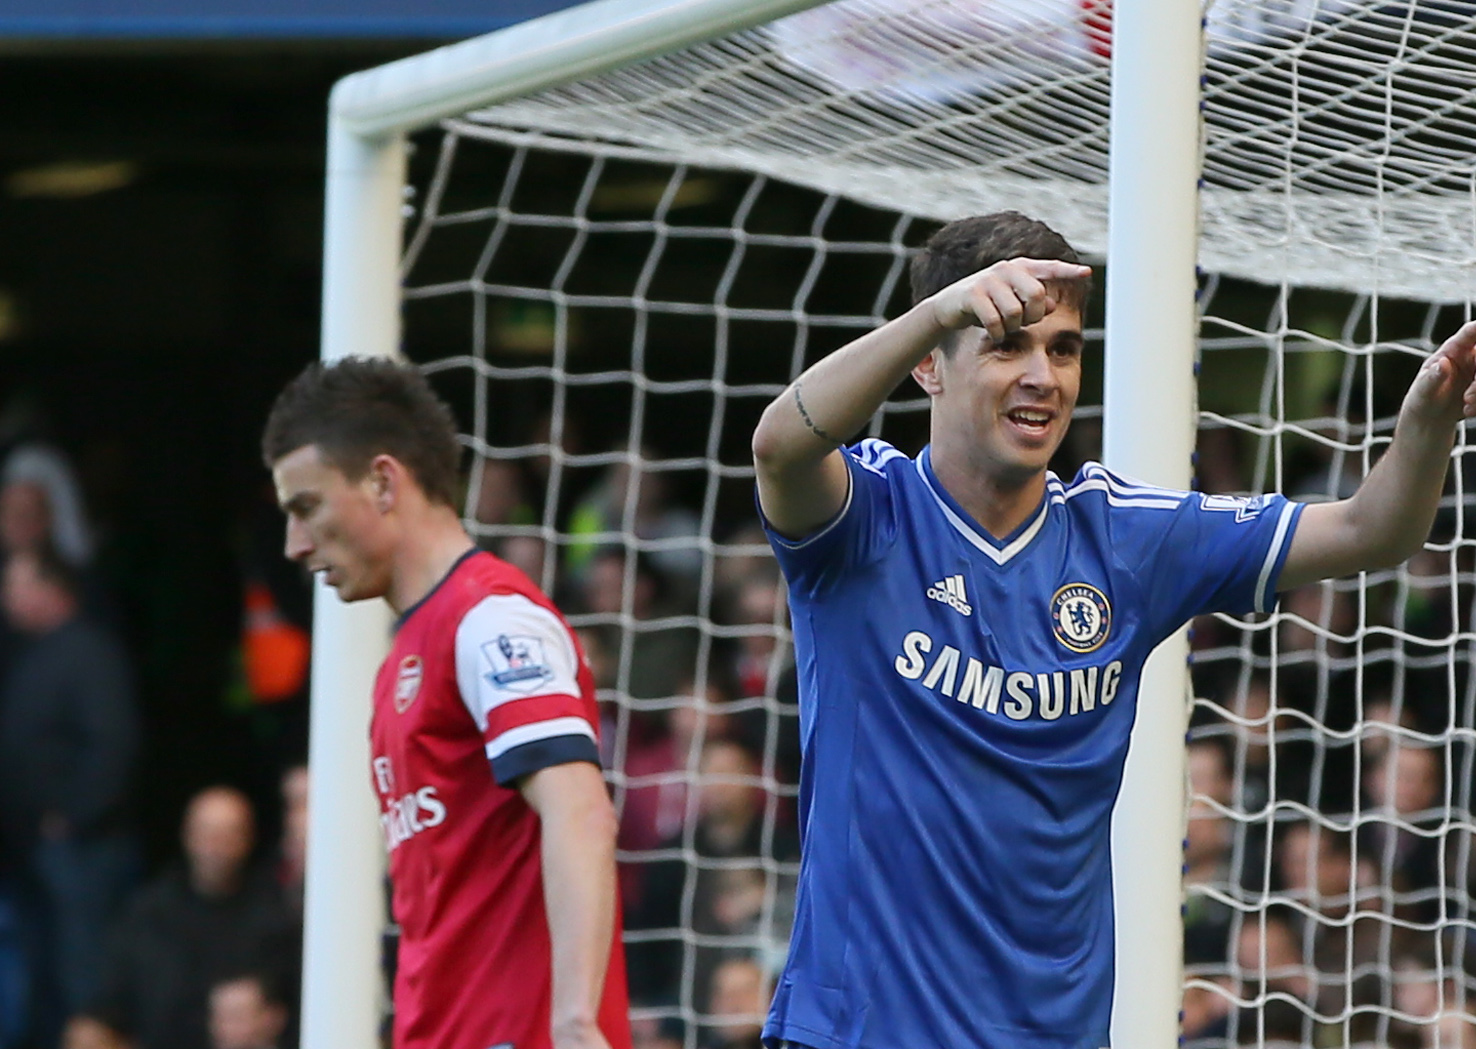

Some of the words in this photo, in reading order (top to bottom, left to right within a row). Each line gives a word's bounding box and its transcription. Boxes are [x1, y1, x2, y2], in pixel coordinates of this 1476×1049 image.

[926, 587, 972, 617] adidas
[1056, 588, 1094, 606] CHELSEA
[895, 631, 1122, 720] SAMSUNG
